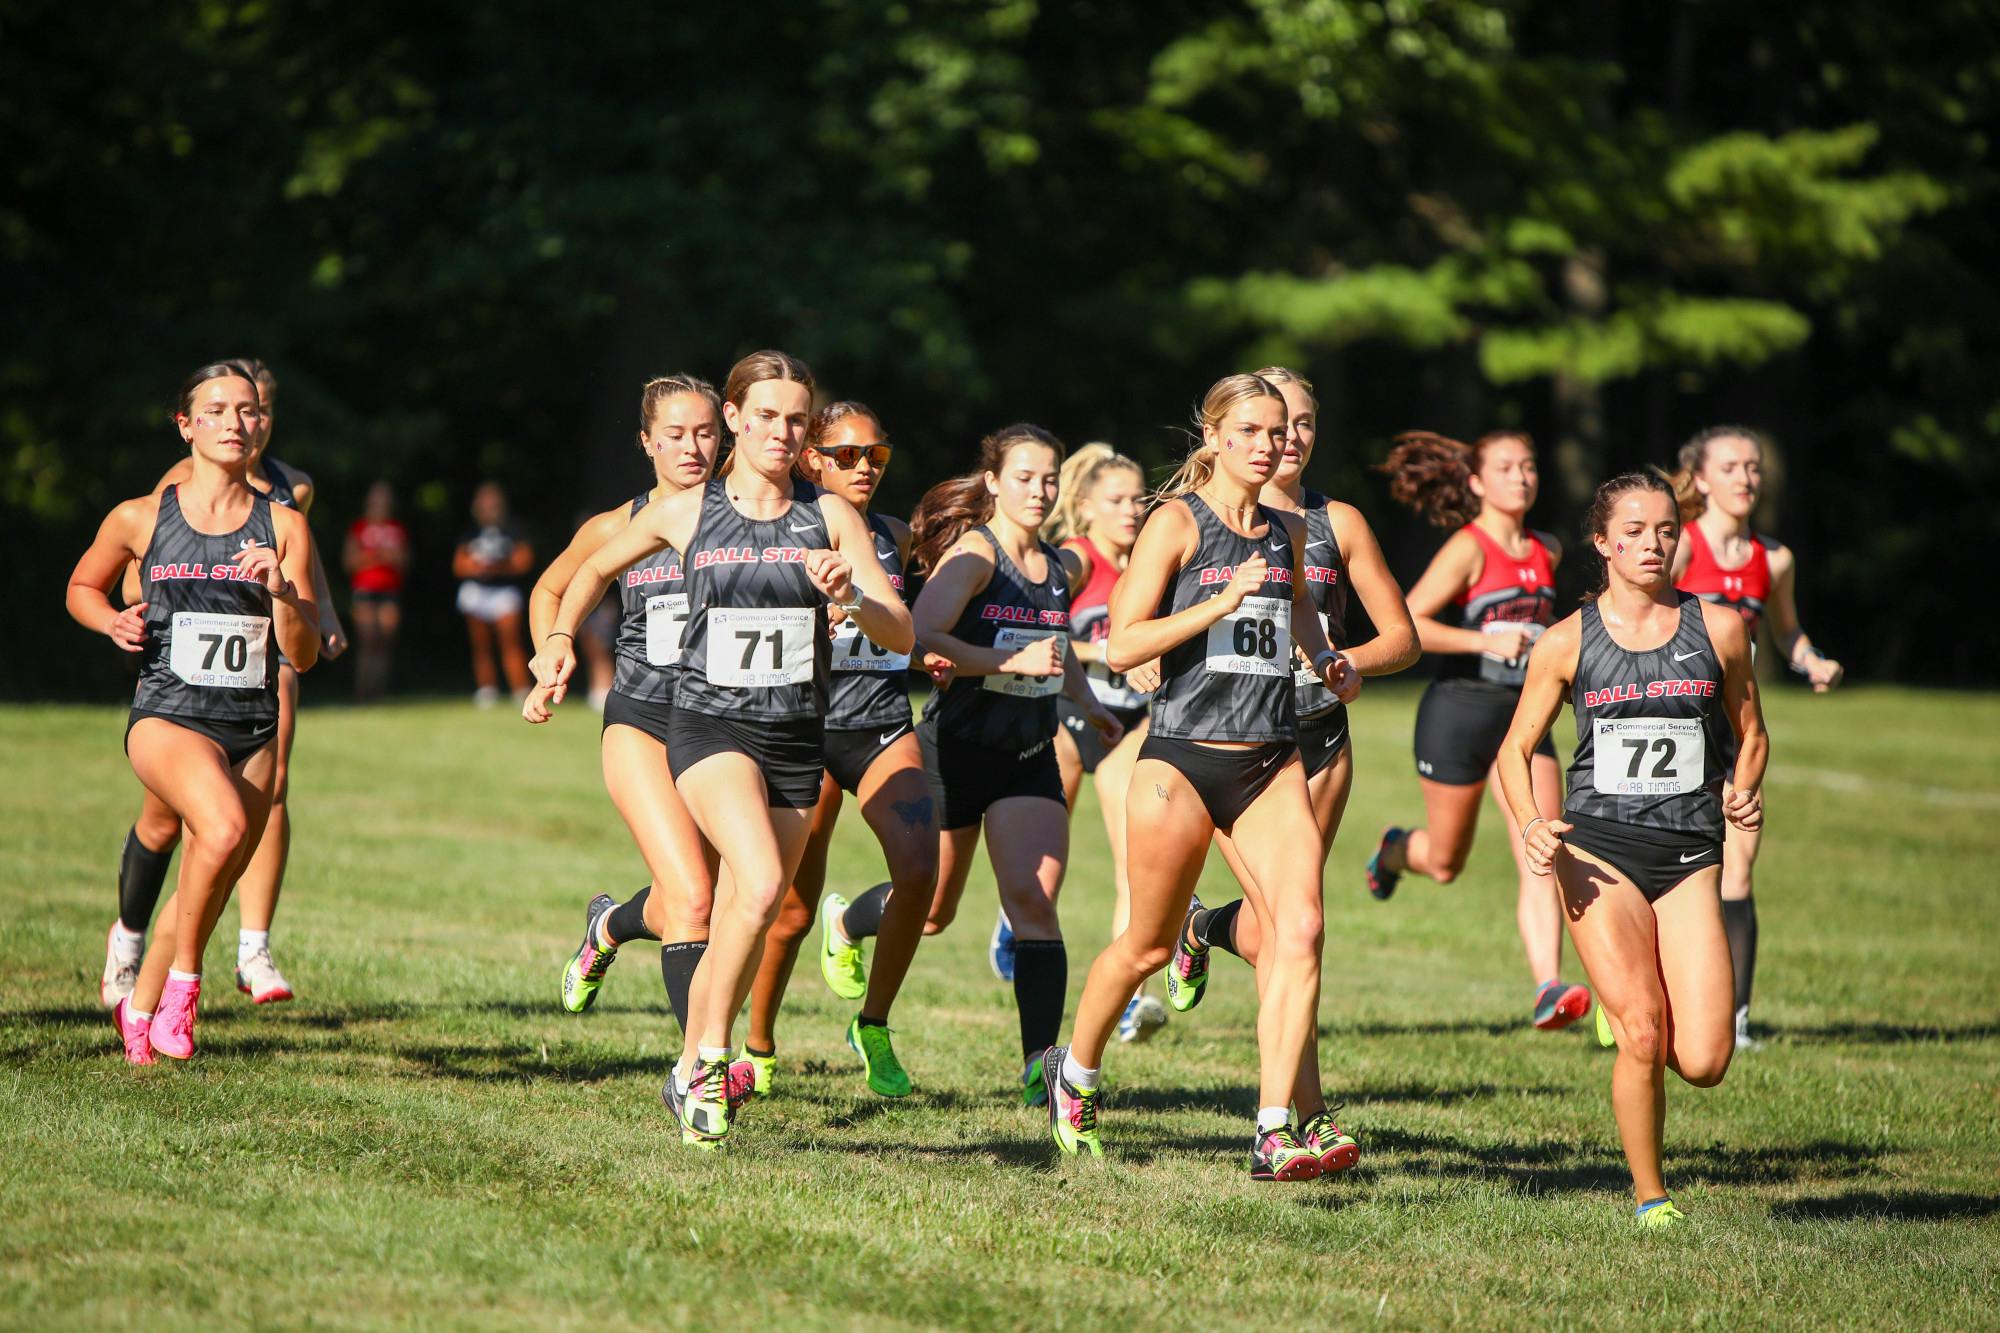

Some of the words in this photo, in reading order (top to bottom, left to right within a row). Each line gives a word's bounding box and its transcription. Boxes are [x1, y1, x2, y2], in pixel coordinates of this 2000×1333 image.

[693, 547, 758, 570] BALL
[151, 563, 208, 582] BALL
[210, 564, 261, 583] STA
[627, 565, 684, 588] BALL
[1200, 566, 1240, 585] BA
[1304, 566, 1338, 584] ATE
[982, 604, 1036, 623] BALL
[1241, 602, 1270, 611] mmercial
[241, 621, 264, 629] Service
[672, 613, 689, 650] 7
[845, 621, 889, 657] 7
[1233, 616, 1278, 660] 68
[198, 633, 248, 672] 70
[735, 629, 783, 670] 71
[1584, 683, 1643, 708] BALL
[1645, 680, 1718, 698] STATE
[1668, 723, 1699, 731] Service
[1622, 738, 1678, 778] 72
[1629, 782, 1643, 793] AB
[1647, 781, 1681, 793] TIMING
[666, 944, 687, 953] RUN
